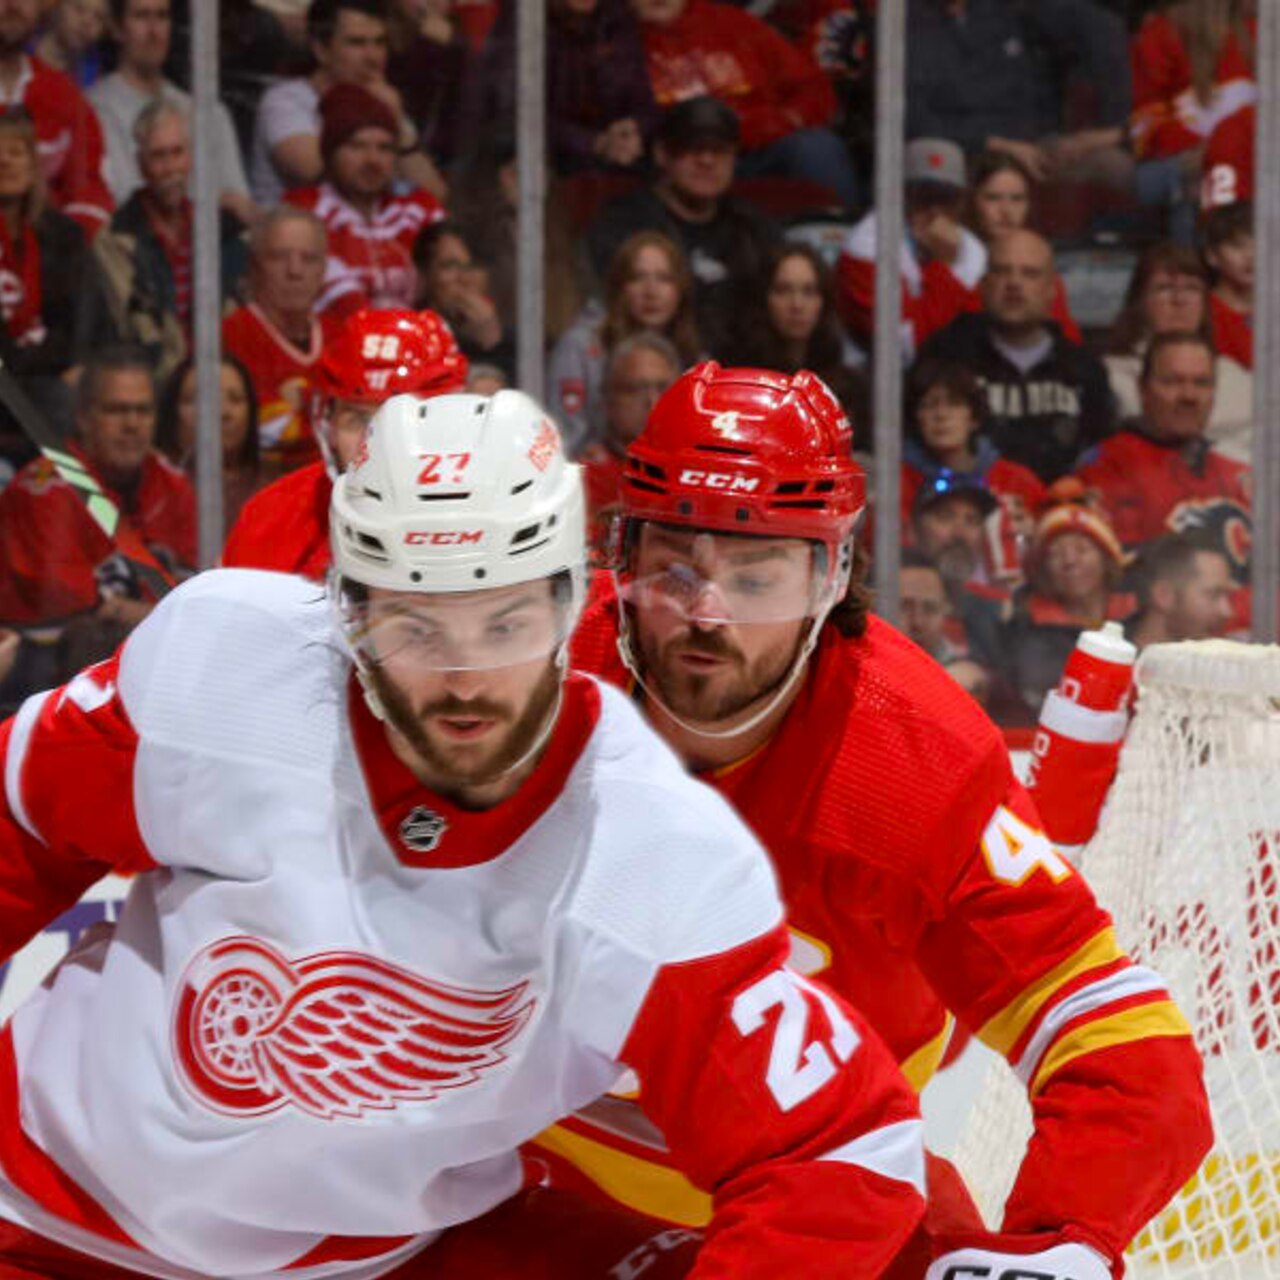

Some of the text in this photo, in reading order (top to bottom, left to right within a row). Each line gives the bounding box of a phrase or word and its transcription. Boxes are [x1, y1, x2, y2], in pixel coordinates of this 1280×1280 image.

[711, 410, 741, 441] 4
[416, 452, 472, 486] 27
[677, 469, 761, 493] CCM
[403, 530, 484, 545] CCM
[981, 805, 1073, 888] 4
